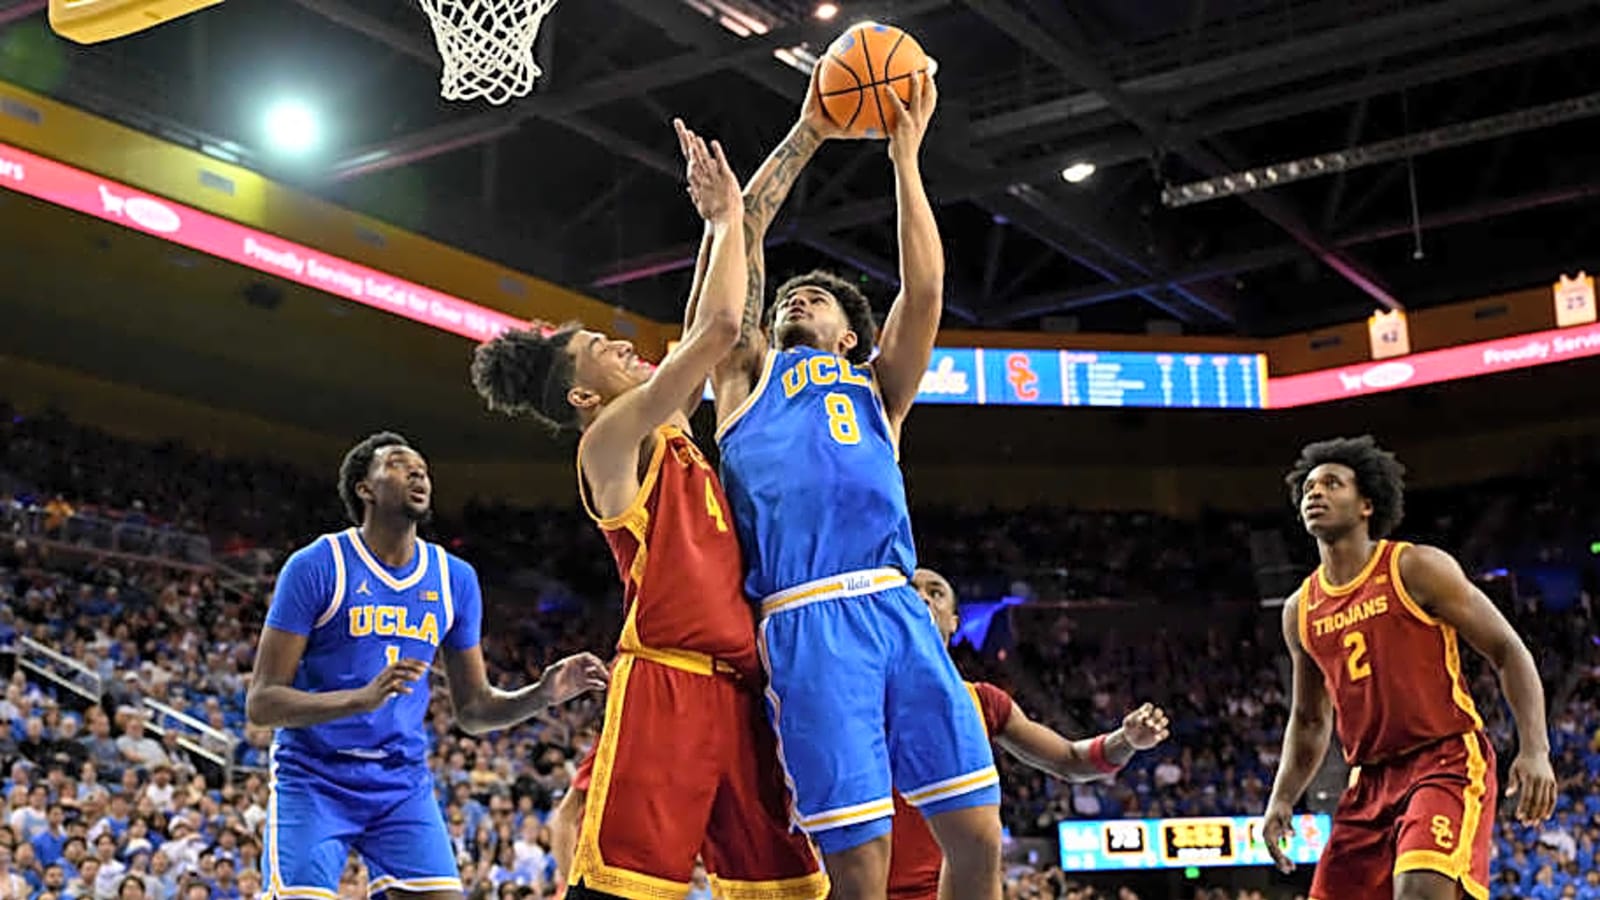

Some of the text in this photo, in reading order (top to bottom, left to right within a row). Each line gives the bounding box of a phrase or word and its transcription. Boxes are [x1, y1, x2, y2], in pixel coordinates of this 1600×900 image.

[244, 237, 304, 275] Proudly
[307, 259, 363, 295] Serving
[430, 301, 462, 324] Over
[1483, 341, 1549, 365] Proudly
[781, 355, 870, 399] UCL
[824, 392, 861, 445] 8
[705, 476, 728, 532] 4
[348, 604, 439, 647] UCLA
[1312, 595, 1388, 637] TROJANS
[1343, 631, 1372, 682] 2
